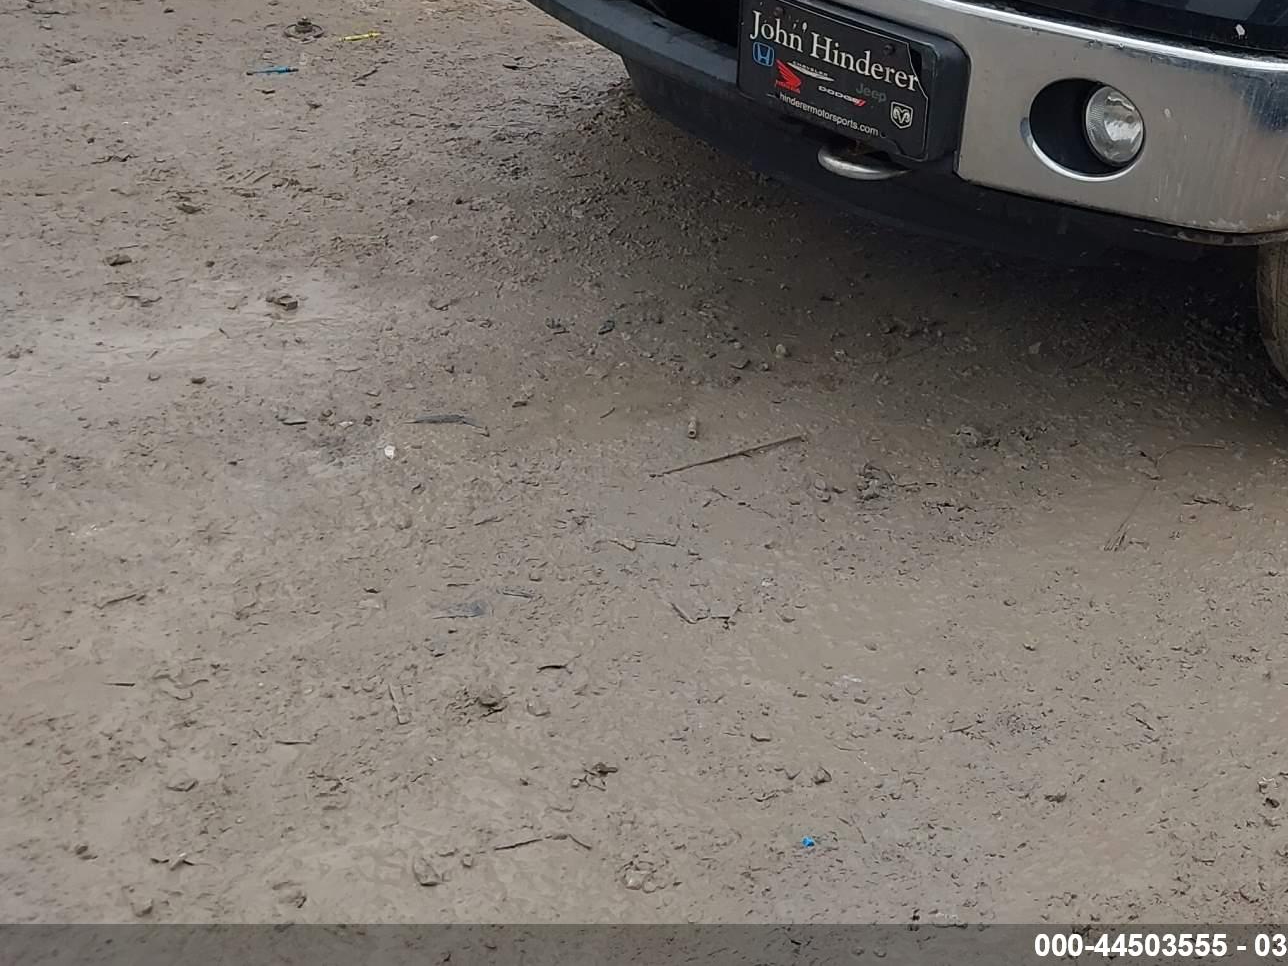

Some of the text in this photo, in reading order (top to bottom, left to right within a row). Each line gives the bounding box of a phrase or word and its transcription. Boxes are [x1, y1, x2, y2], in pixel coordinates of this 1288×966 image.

[750, 10, 919, 92] John Hinderer
[779, 92, 879, 136] hinderermotorsports.com
[855, 83, 887, 103] Jeep
